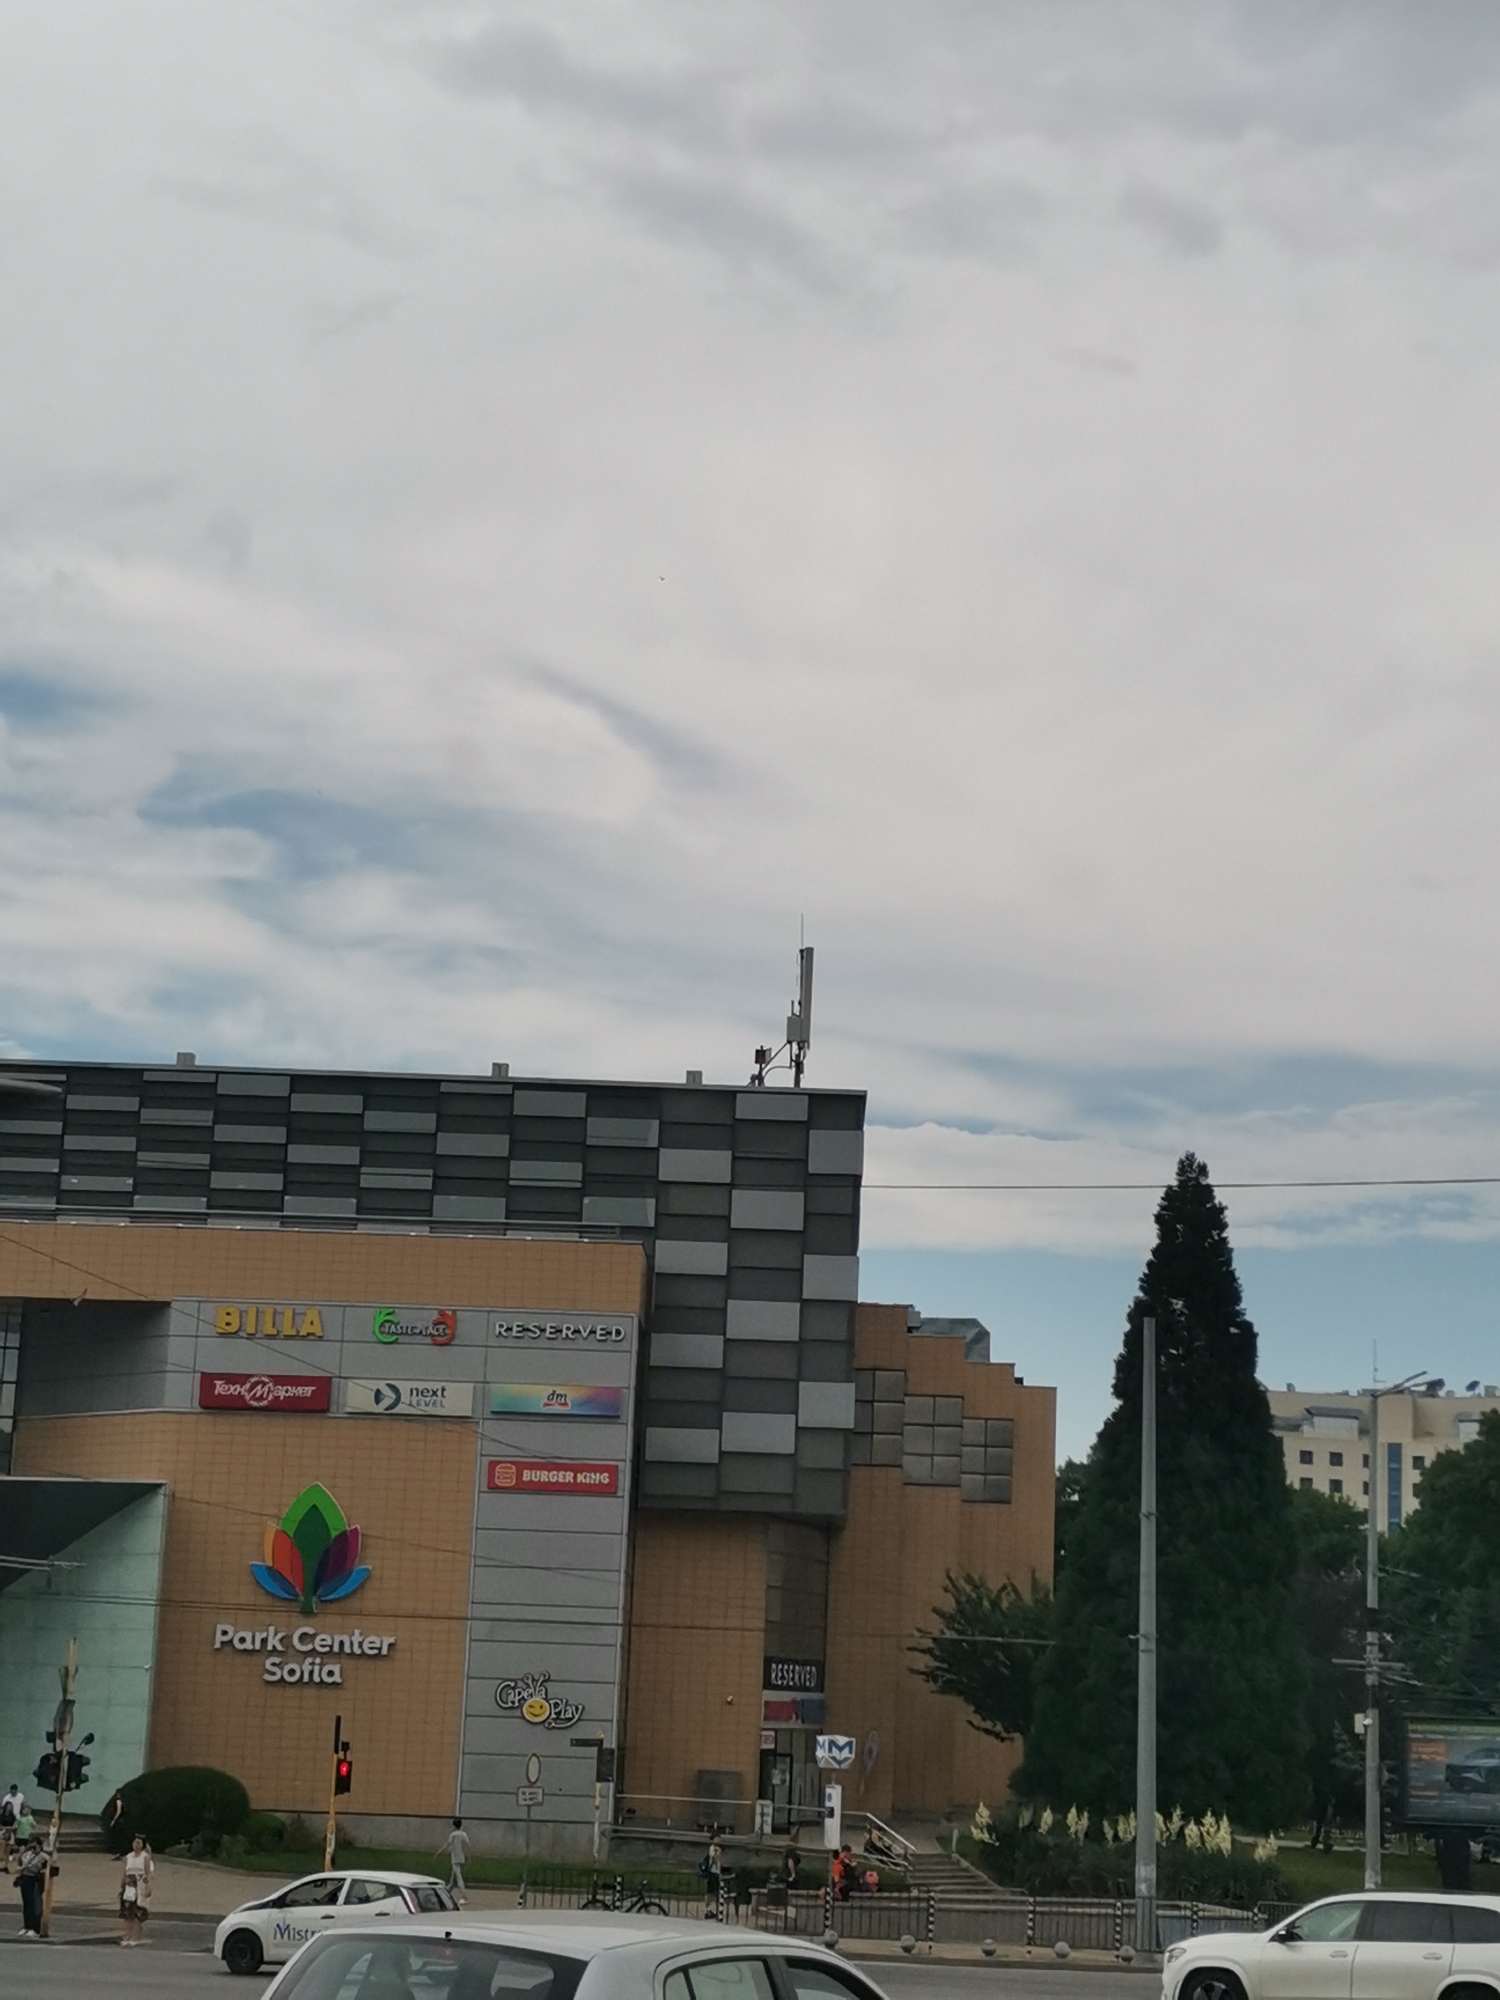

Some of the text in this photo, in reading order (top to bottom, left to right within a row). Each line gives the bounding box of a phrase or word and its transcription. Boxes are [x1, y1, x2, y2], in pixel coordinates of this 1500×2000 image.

[216, 1305, 323, 1337] BILLA
[495, 1322, 625, 1341] RESERVED
[409, 1398, 446, 1409] LEVEL
[410, 1385, 447, 1399] next
[547, 1390, 567, 1403] dm
[522, 1469, 574, 1483] BURGER
[577, 1472, 610, 1484] KING
[213, 1623, 397, 1656] Park Center
[262, 1656, 342, 1684] Sofia
[770, 1663, 818, 1687] RESERVED
[496, 1670, 547, 1708] Capella
[545, 1698, 585, 1728] Play
